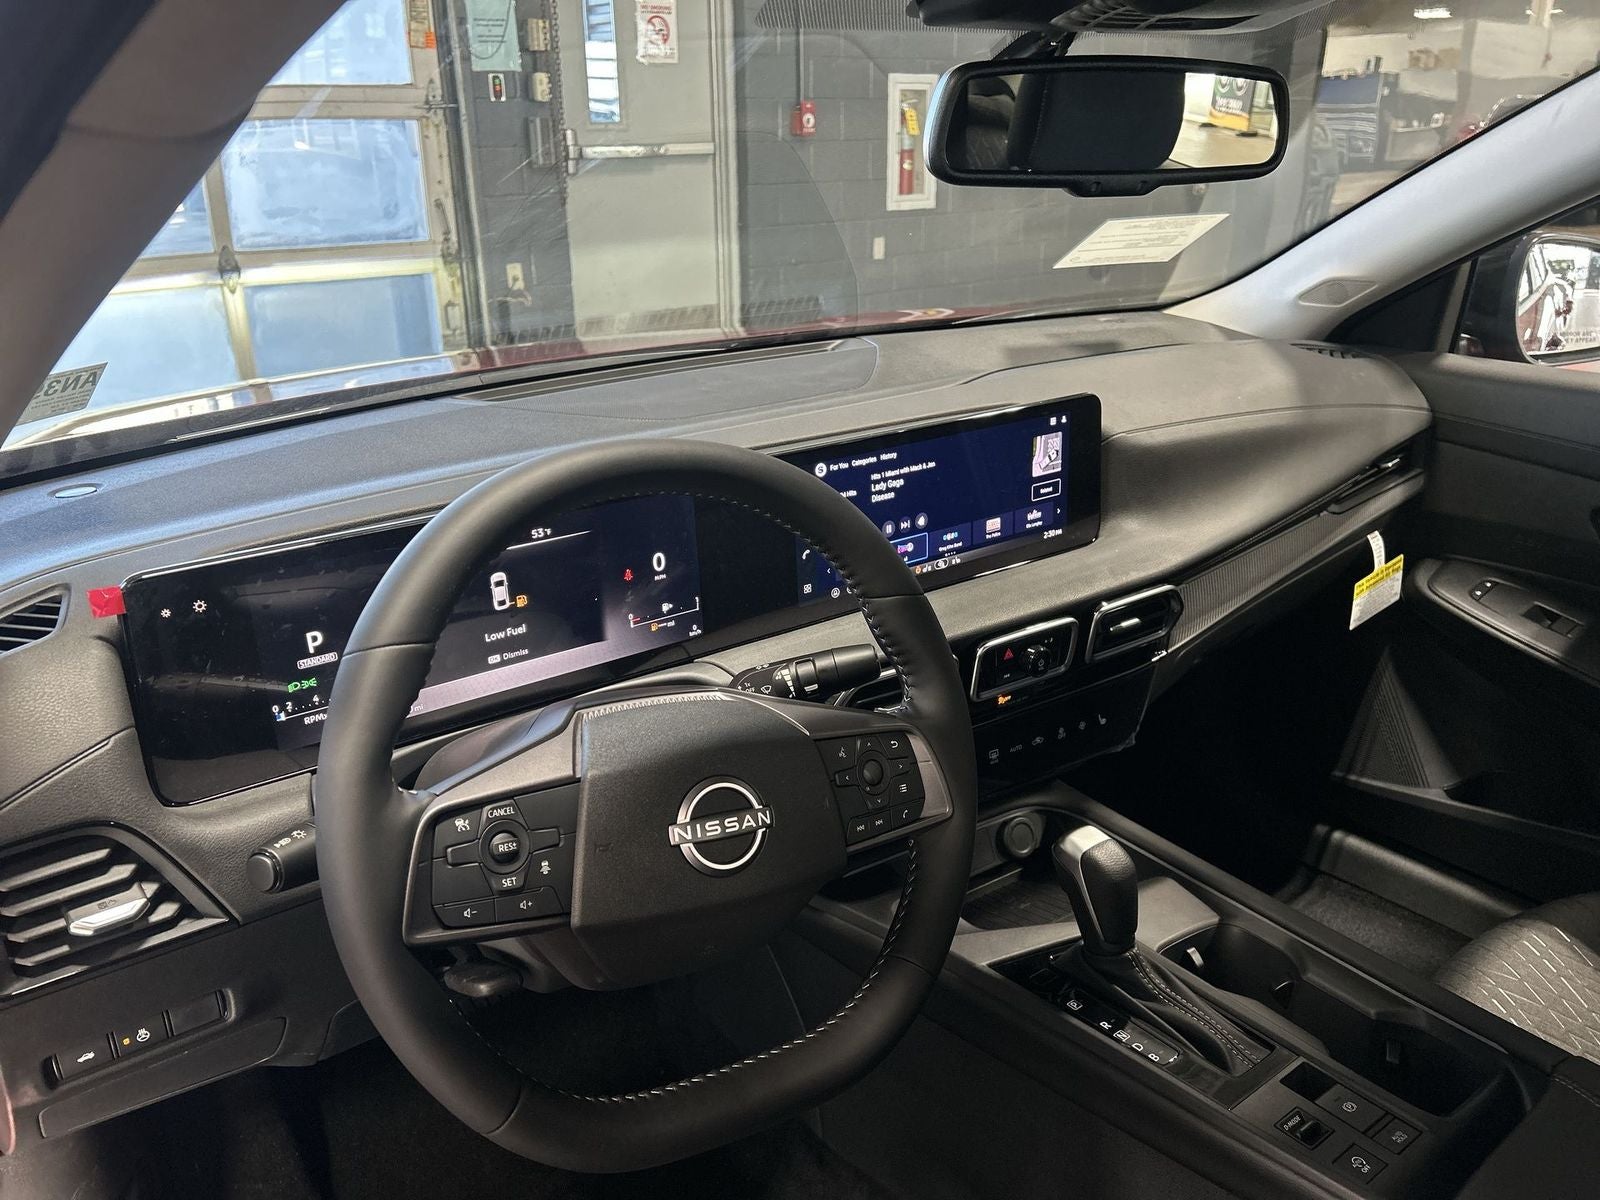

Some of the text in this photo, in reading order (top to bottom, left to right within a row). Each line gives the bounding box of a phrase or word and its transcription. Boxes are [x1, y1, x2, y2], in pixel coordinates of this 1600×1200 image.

[852, 456, 877, 467] Categories
[880, 452, 898, 461] History
[871, 478, 904, 492] Lady Gaga
[872, 491, 895, 502] Disease
[652, 552, 666, 572] 0
[484, 624, 527, 643] Low Fuel
[306, 630, 323, 654] P
[502, 648, 529, 660] Dismiss
[299, 653, 337, 668] STANDARD
[272, 694, 320, 713] 0 2 4
[1010, 744, 1022, 753] AUTO
[488, 806, 515, 818] CANCEL
[673, 810, 771, 842] NISSAN
[502, 876, 516, 888] SET
[1100, 1021, 1112, 1030] R
[1132, 1042, 1144, 1052] D
[1148, 1053, 1160, 1062] B
[1283, 1114, 1301, 1131] D-MODE
